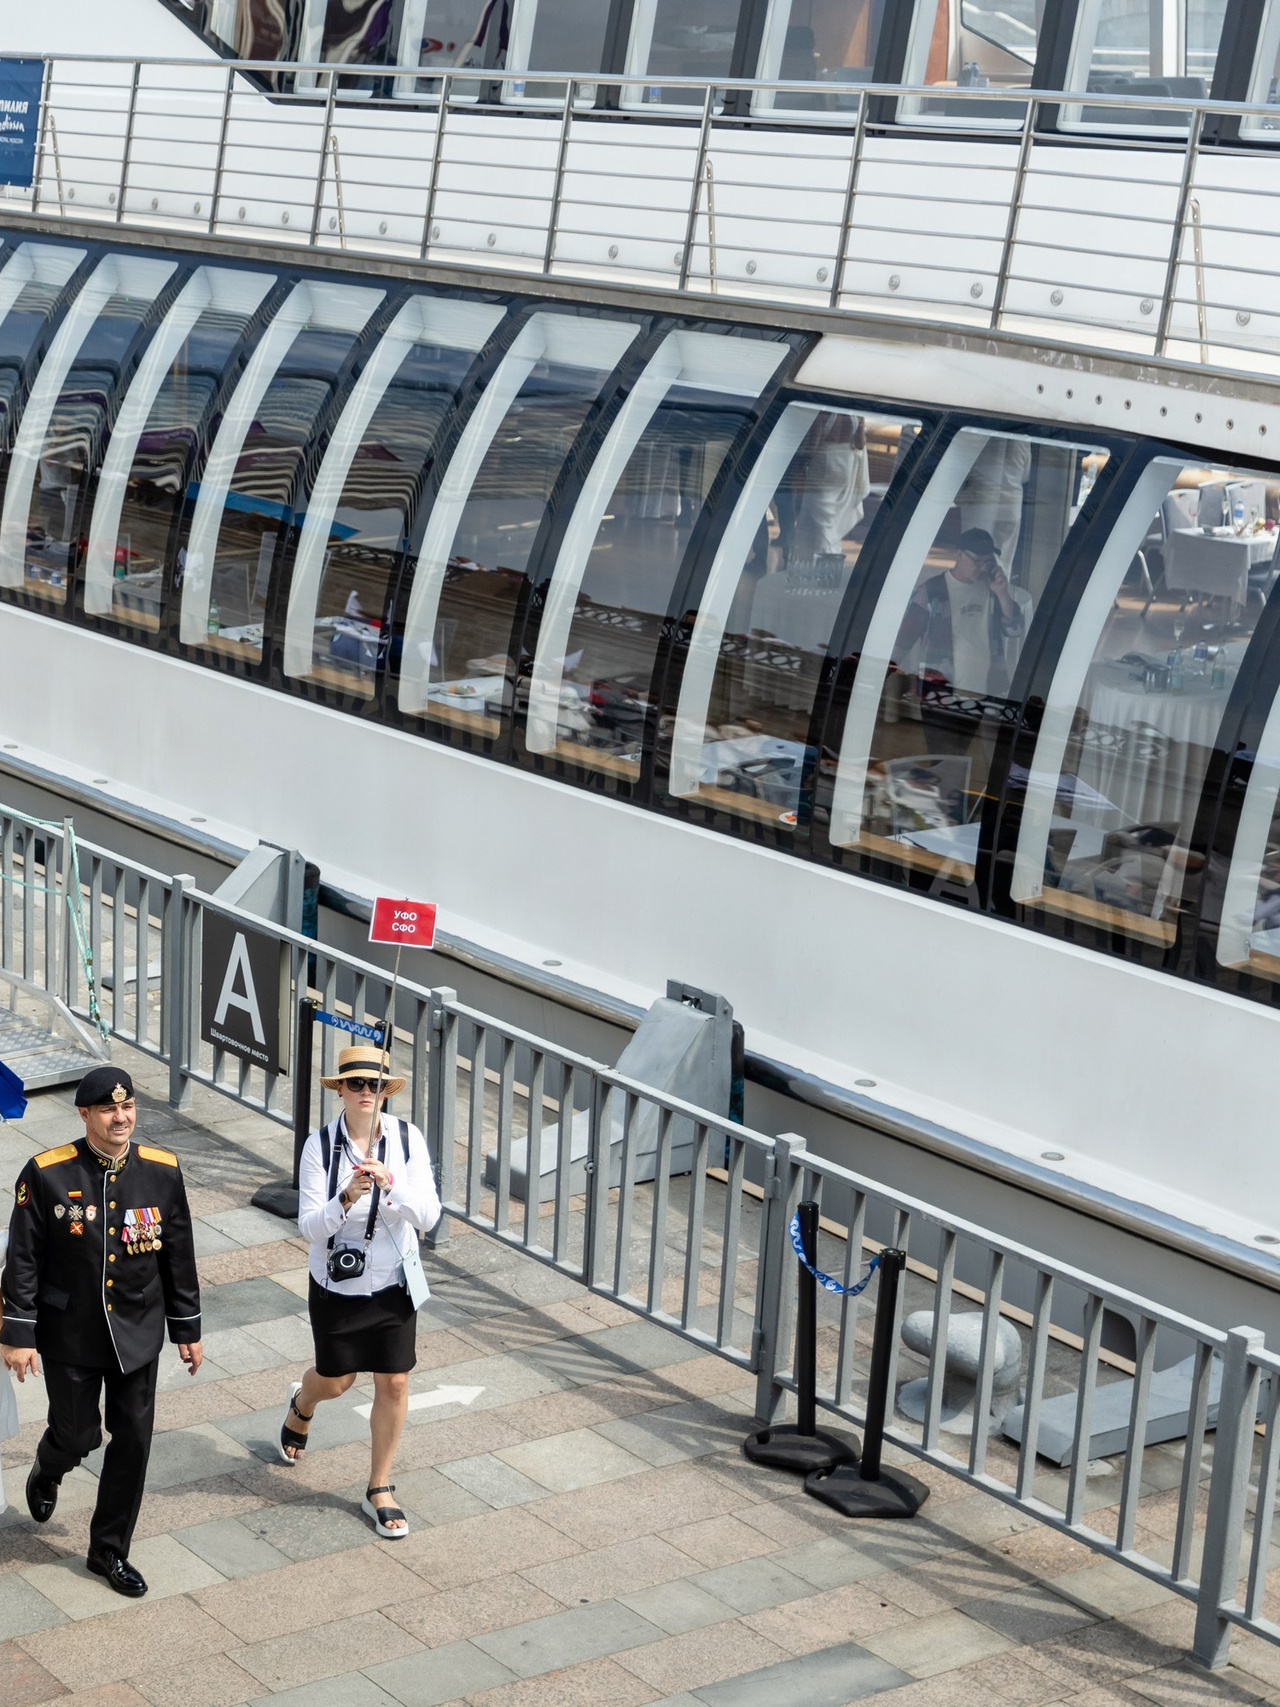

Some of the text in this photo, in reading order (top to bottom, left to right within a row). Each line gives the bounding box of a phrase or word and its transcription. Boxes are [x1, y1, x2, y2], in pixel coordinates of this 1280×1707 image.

[394, 910, 418, 921] УФО
[391, 922, 416, 934] СФО
[210, 1027, 269, 1062] Швартовочное место
